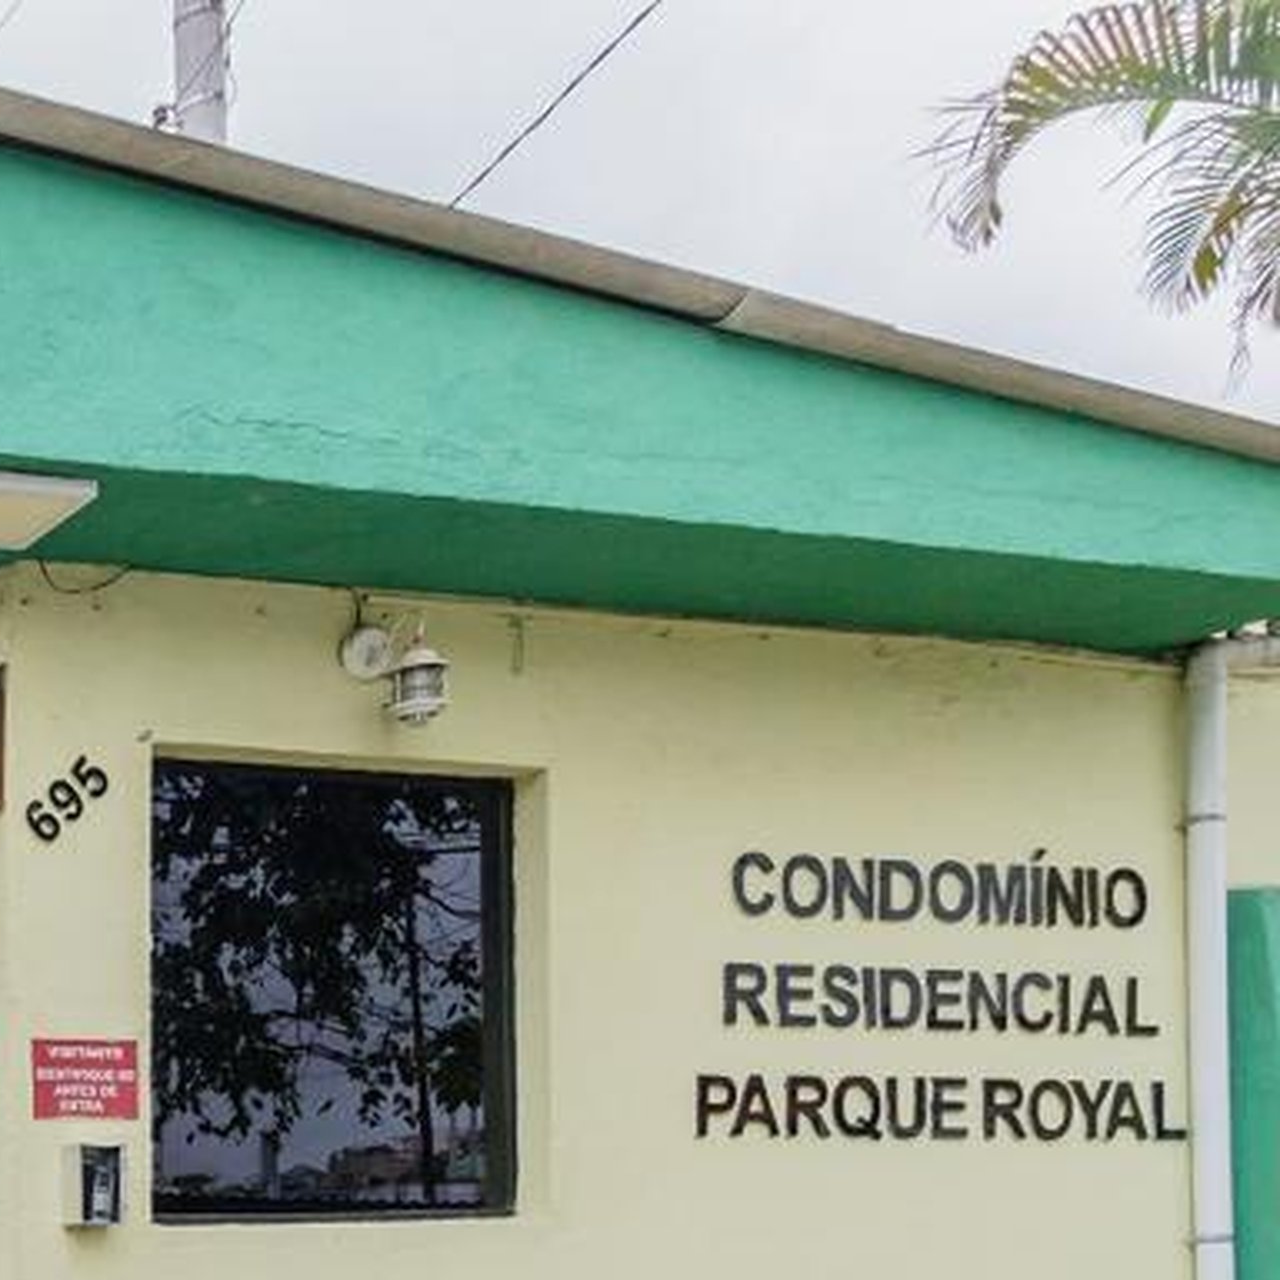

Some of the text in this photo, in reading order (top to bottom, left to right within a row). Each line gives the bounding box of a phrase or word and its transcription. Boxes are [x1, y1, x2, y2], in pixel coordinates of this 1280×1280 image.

[26, 755, 109, 843] 695
[731, 847, 1148, 930] CONDOMÍNIO
[722, 962, 1160, 1038] RESIDENCIAL
[695, 1073, 1188, 1143] PARQUE ROYAL
